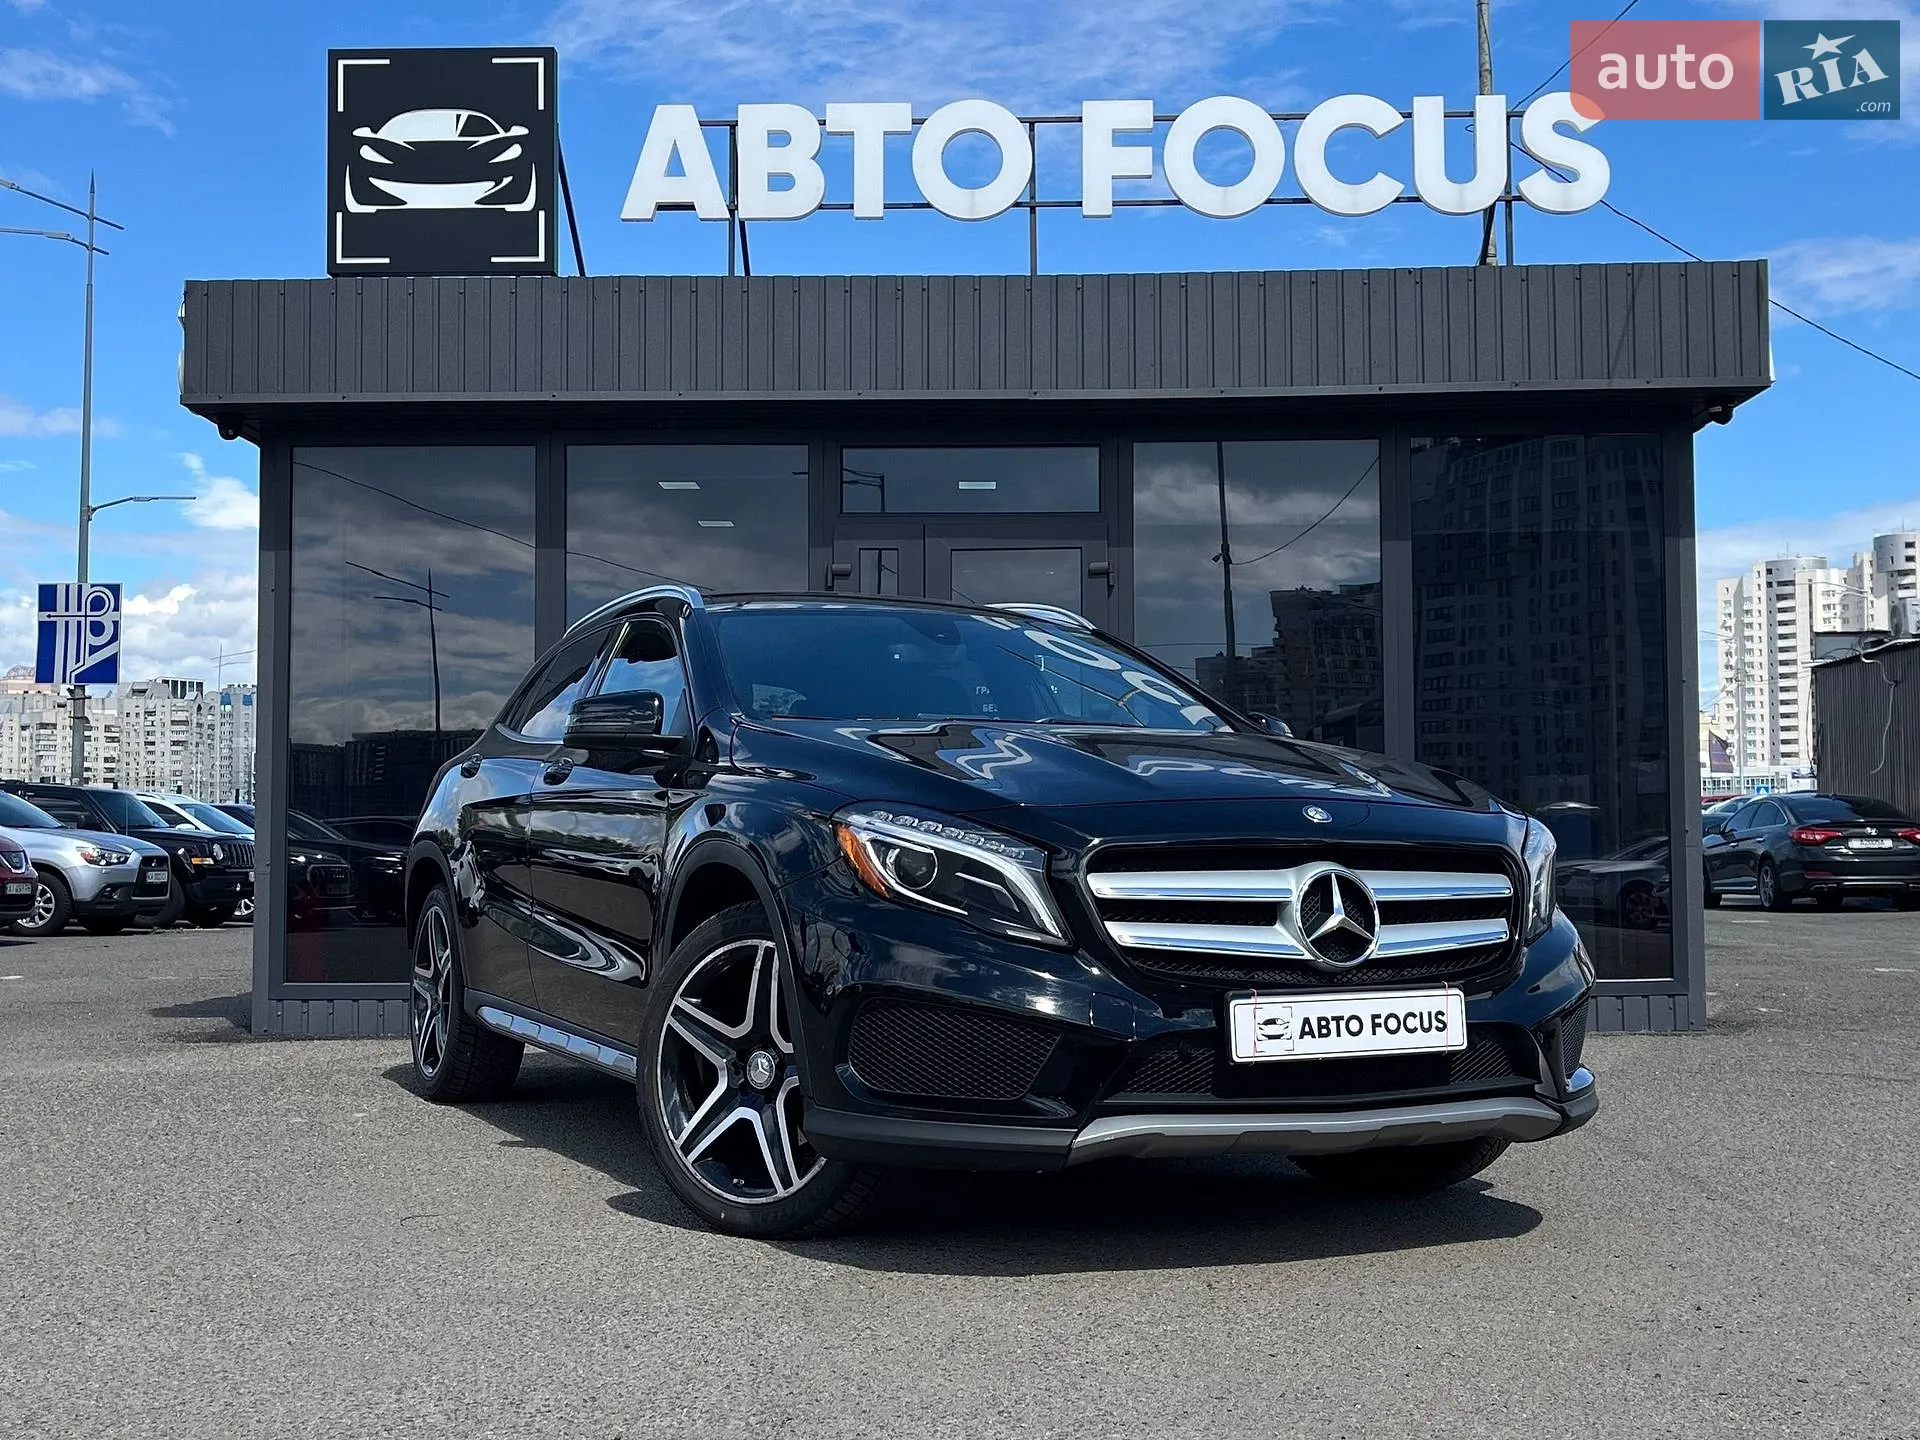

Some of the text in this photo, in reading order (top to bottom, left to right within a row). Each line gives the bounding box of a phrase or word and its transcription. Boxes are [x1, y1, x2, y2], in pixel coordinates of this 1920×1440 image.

[620, 91, 1612, 222] АВТО FOCUS
[1298, 1009, 1448, 1040] АВТО FOCUS
